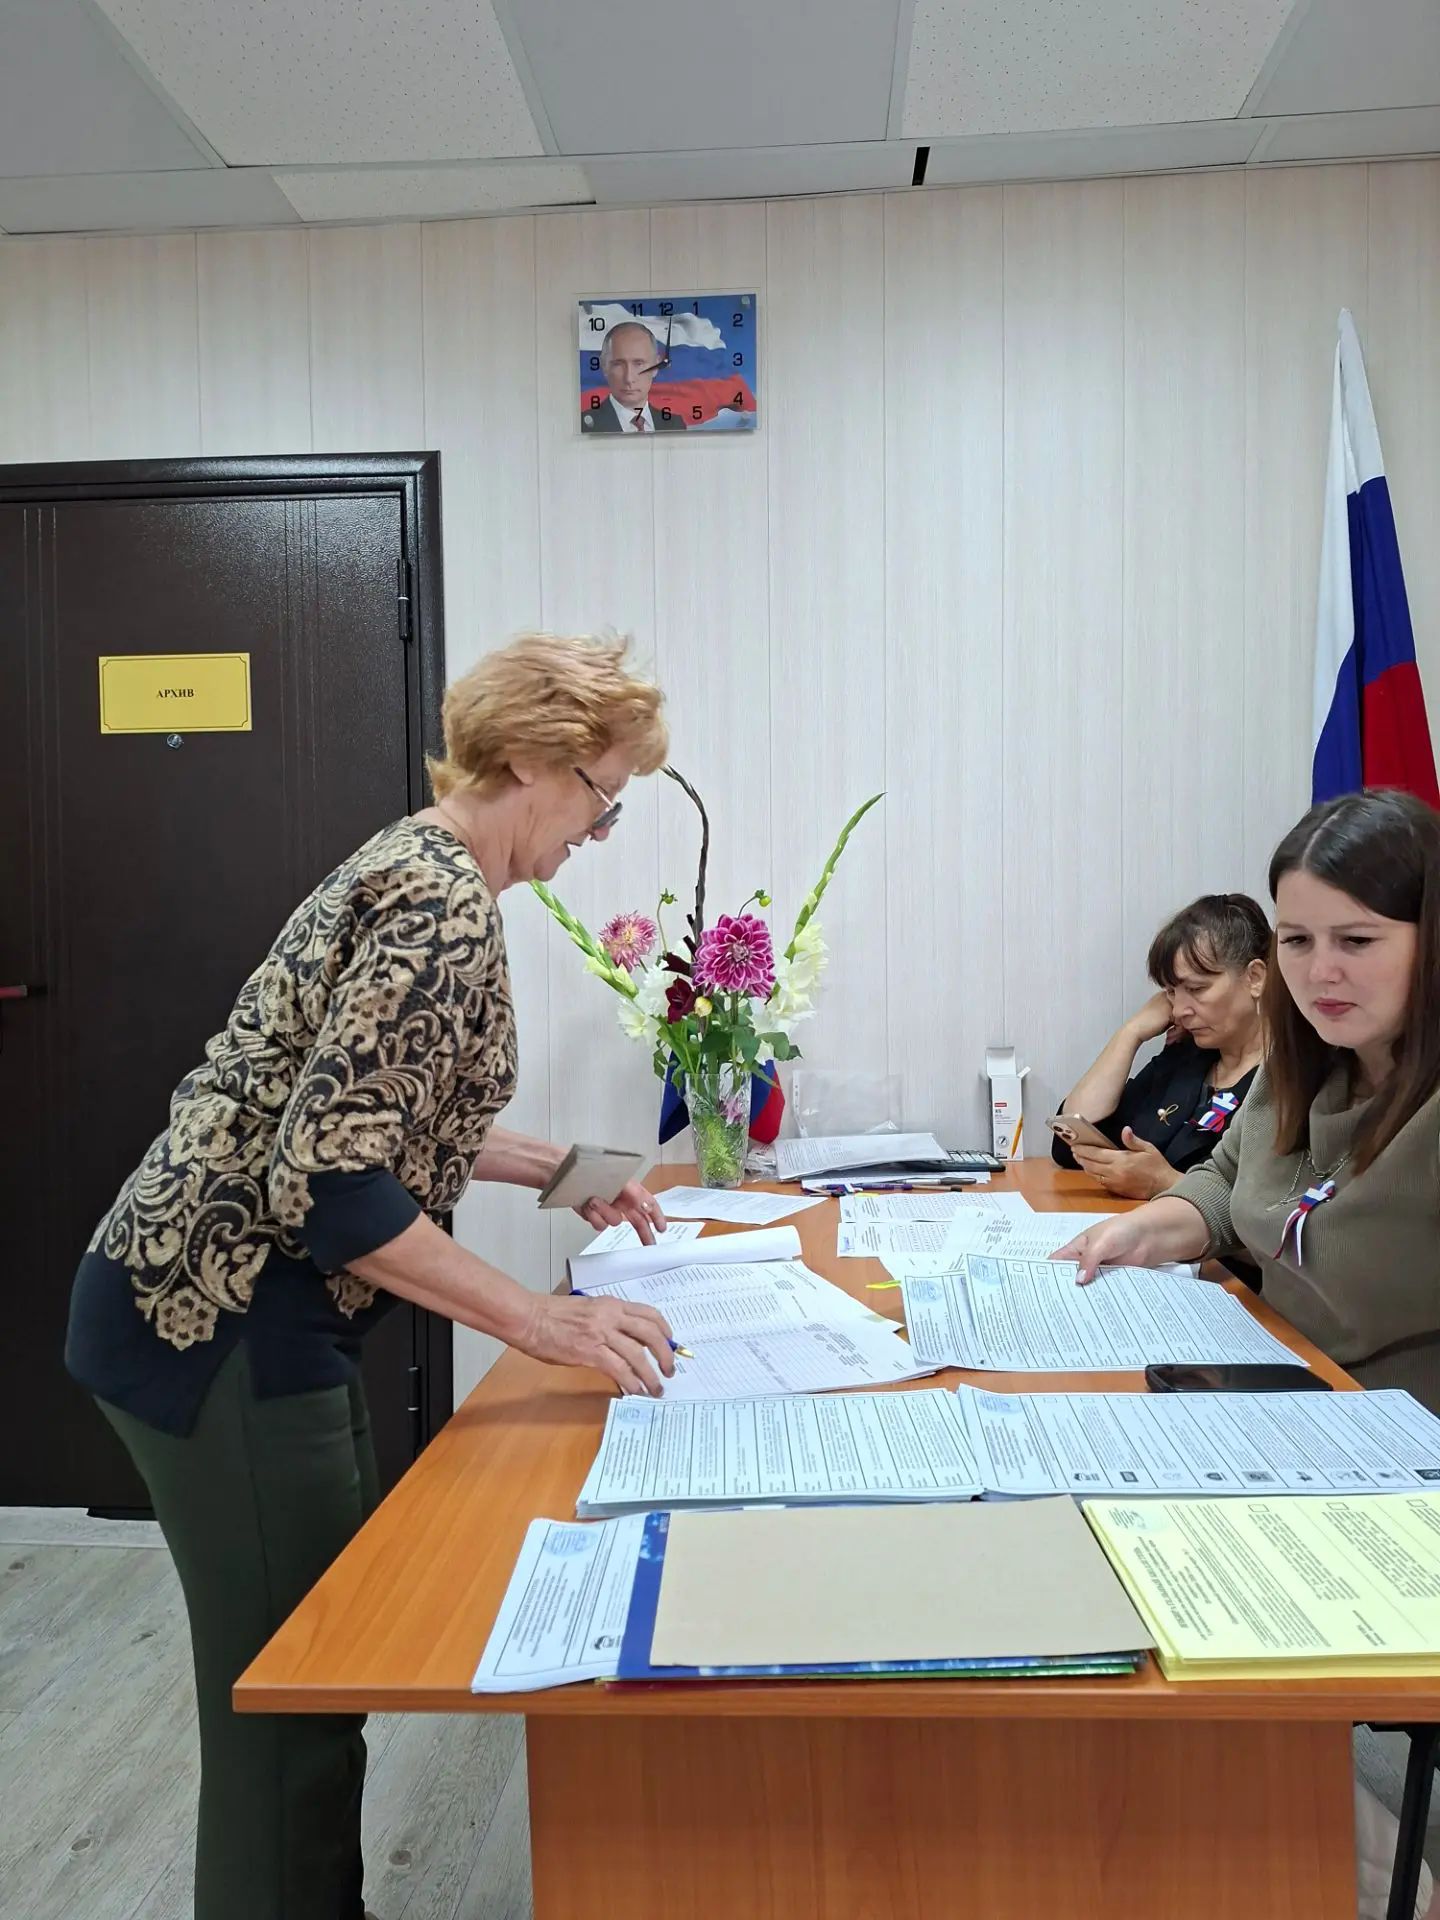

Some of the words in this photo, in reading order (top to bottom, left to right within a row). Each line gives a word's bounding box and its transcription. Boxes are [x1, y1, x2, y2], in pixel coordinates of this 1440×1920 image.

[631, 303, 643, 316] 11
[659, 302, 673, 316] 12
[589, 317, 605, 331] 10
[733, 313, 743, 327] 2
[590, 357, 600, 370] 9
[733, 352, 743, 366] 3
[591, 396, 601, 409] 8
[733, 392, 743, 405] 4
[634, 408, 644, 421] 7
[662, 407, 671, 420] 6
[693, 406, 702, 419] 5
[157, 689, 195, 698] АРХИВ
